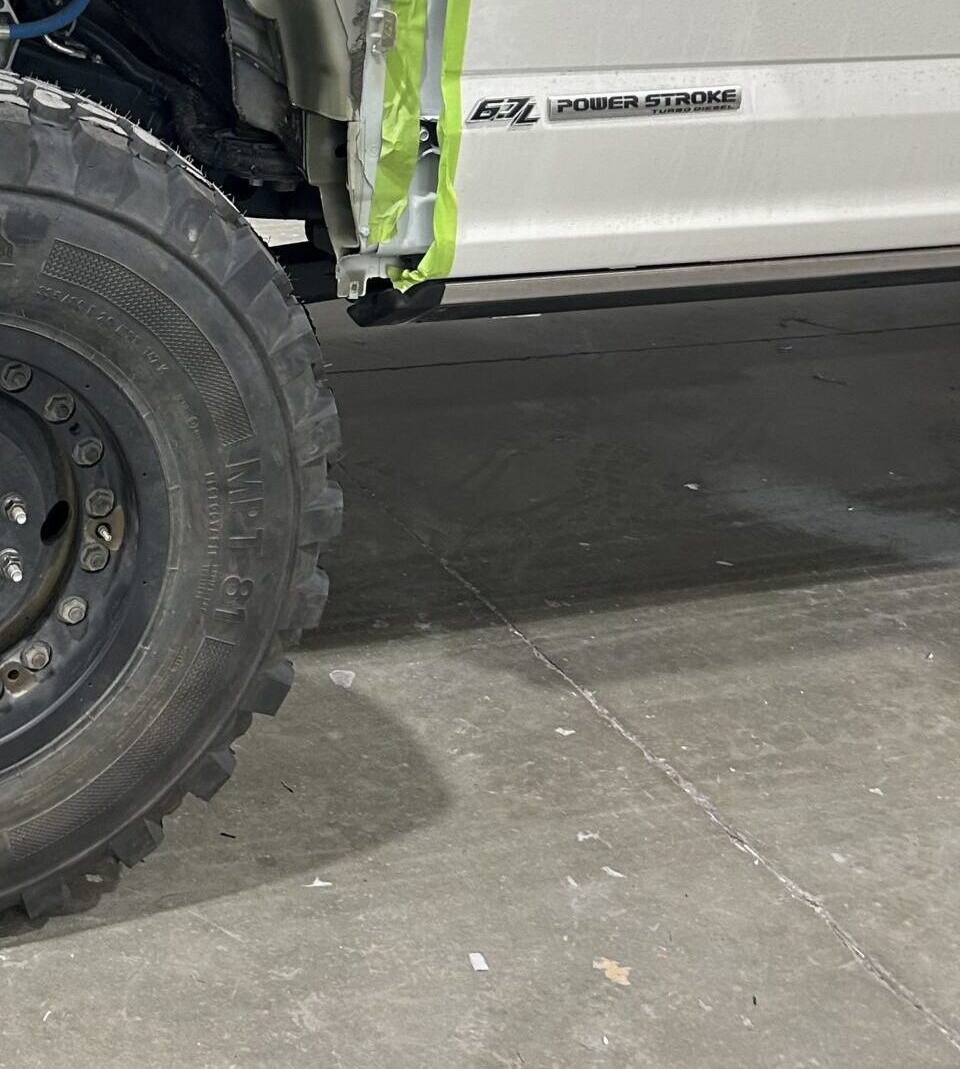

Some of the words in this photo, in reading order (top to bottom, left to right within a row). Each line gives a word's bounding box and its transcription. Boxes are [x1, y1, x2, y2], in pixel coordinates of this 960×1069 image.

[557, 94, 639, 113] POWER
[645, 88, 737, 108] STROKE
[226, 457, 265, 556] MPT
[213, 575, 255, 621] 81
